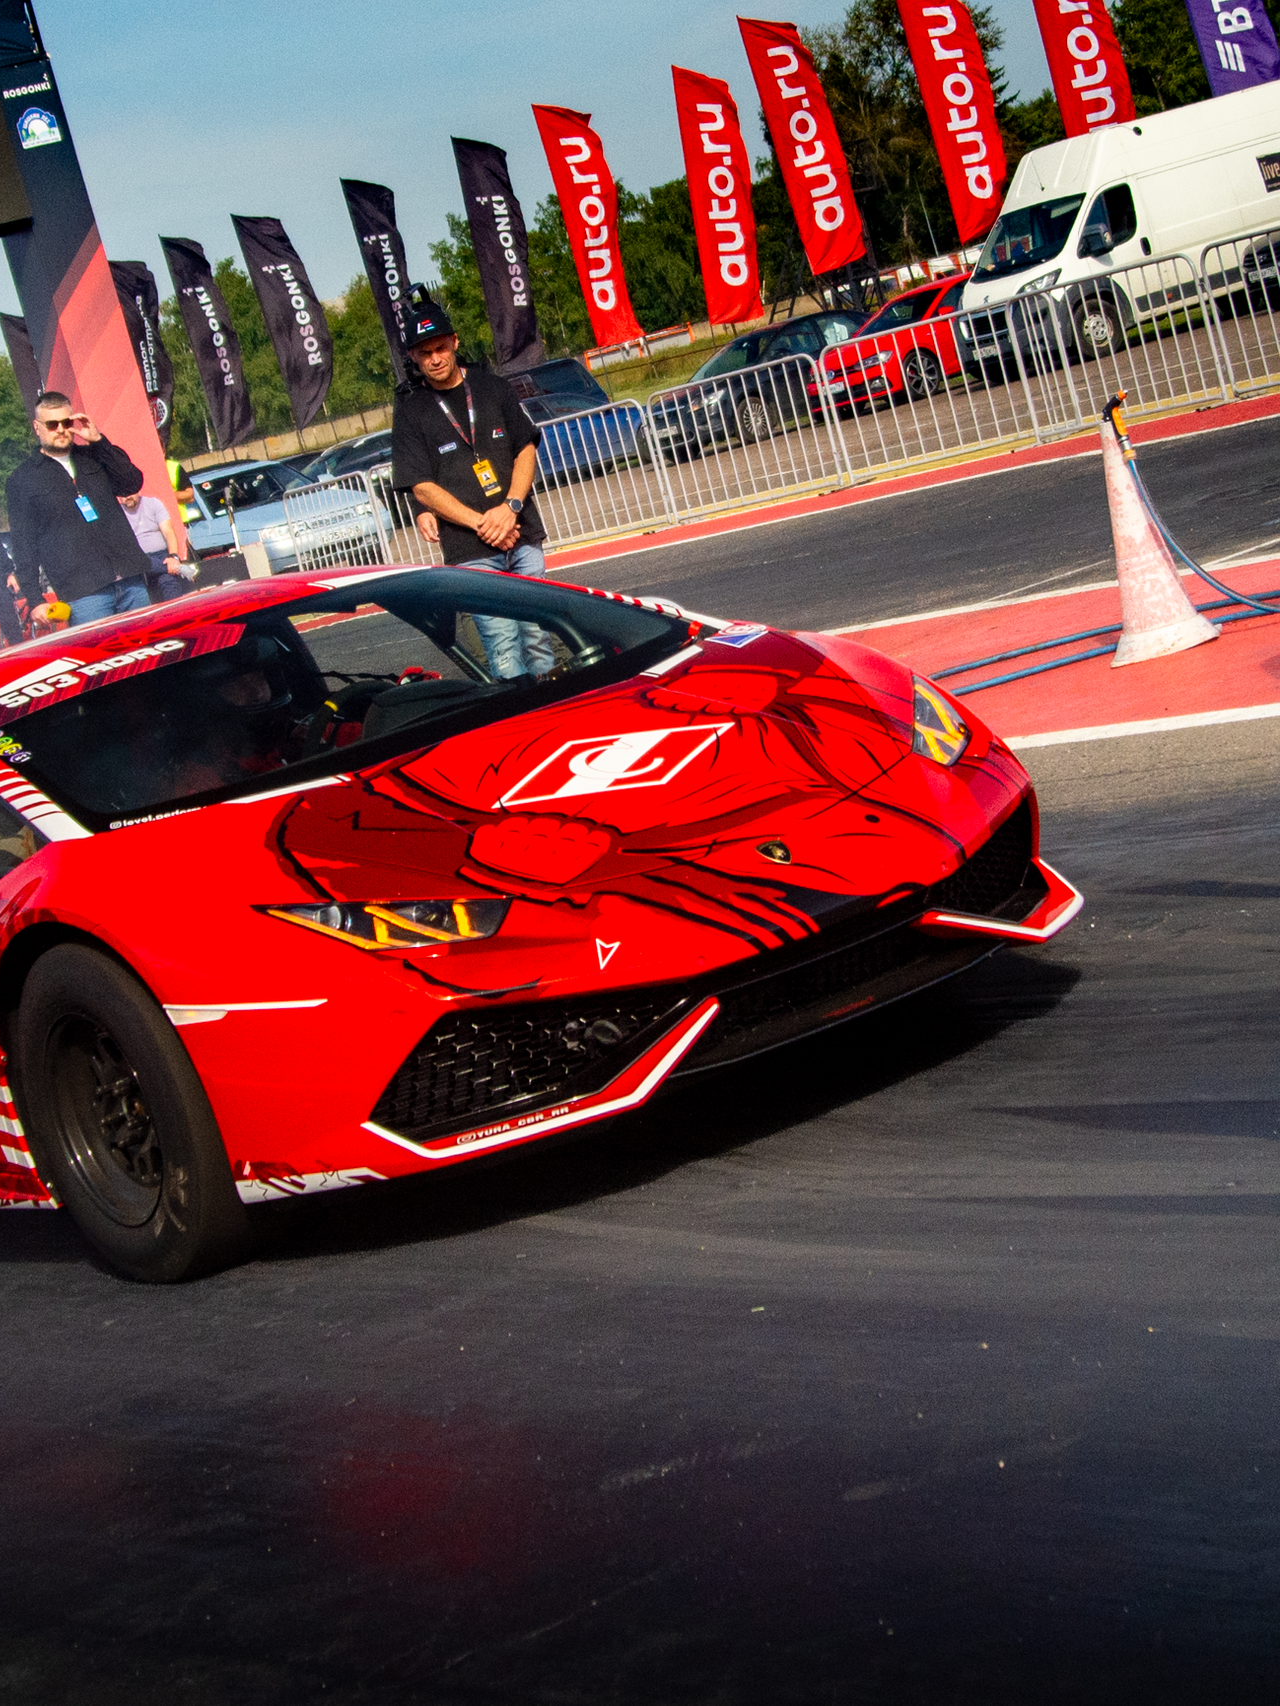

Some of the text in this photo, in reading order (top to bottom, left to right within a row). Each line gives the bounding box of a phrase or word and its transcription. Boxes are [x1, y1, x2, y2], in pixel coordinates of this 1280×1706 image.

[2, 81, 51, 99] ROSGONKI
[766, 45, 844, 233] auto.ru
[922, 6, 995, 200] auto.ru
[492, 195, 528, 306] ROSGONKI
[558, 137, 616, 311] auto.ru
[696, 103, 750, 288] auto.ru
[194, 286, 235, 386] ROSGONKI
[276, 263, 322, 366] ROSGONKI
[77, 639, 186, 677] RDRC
